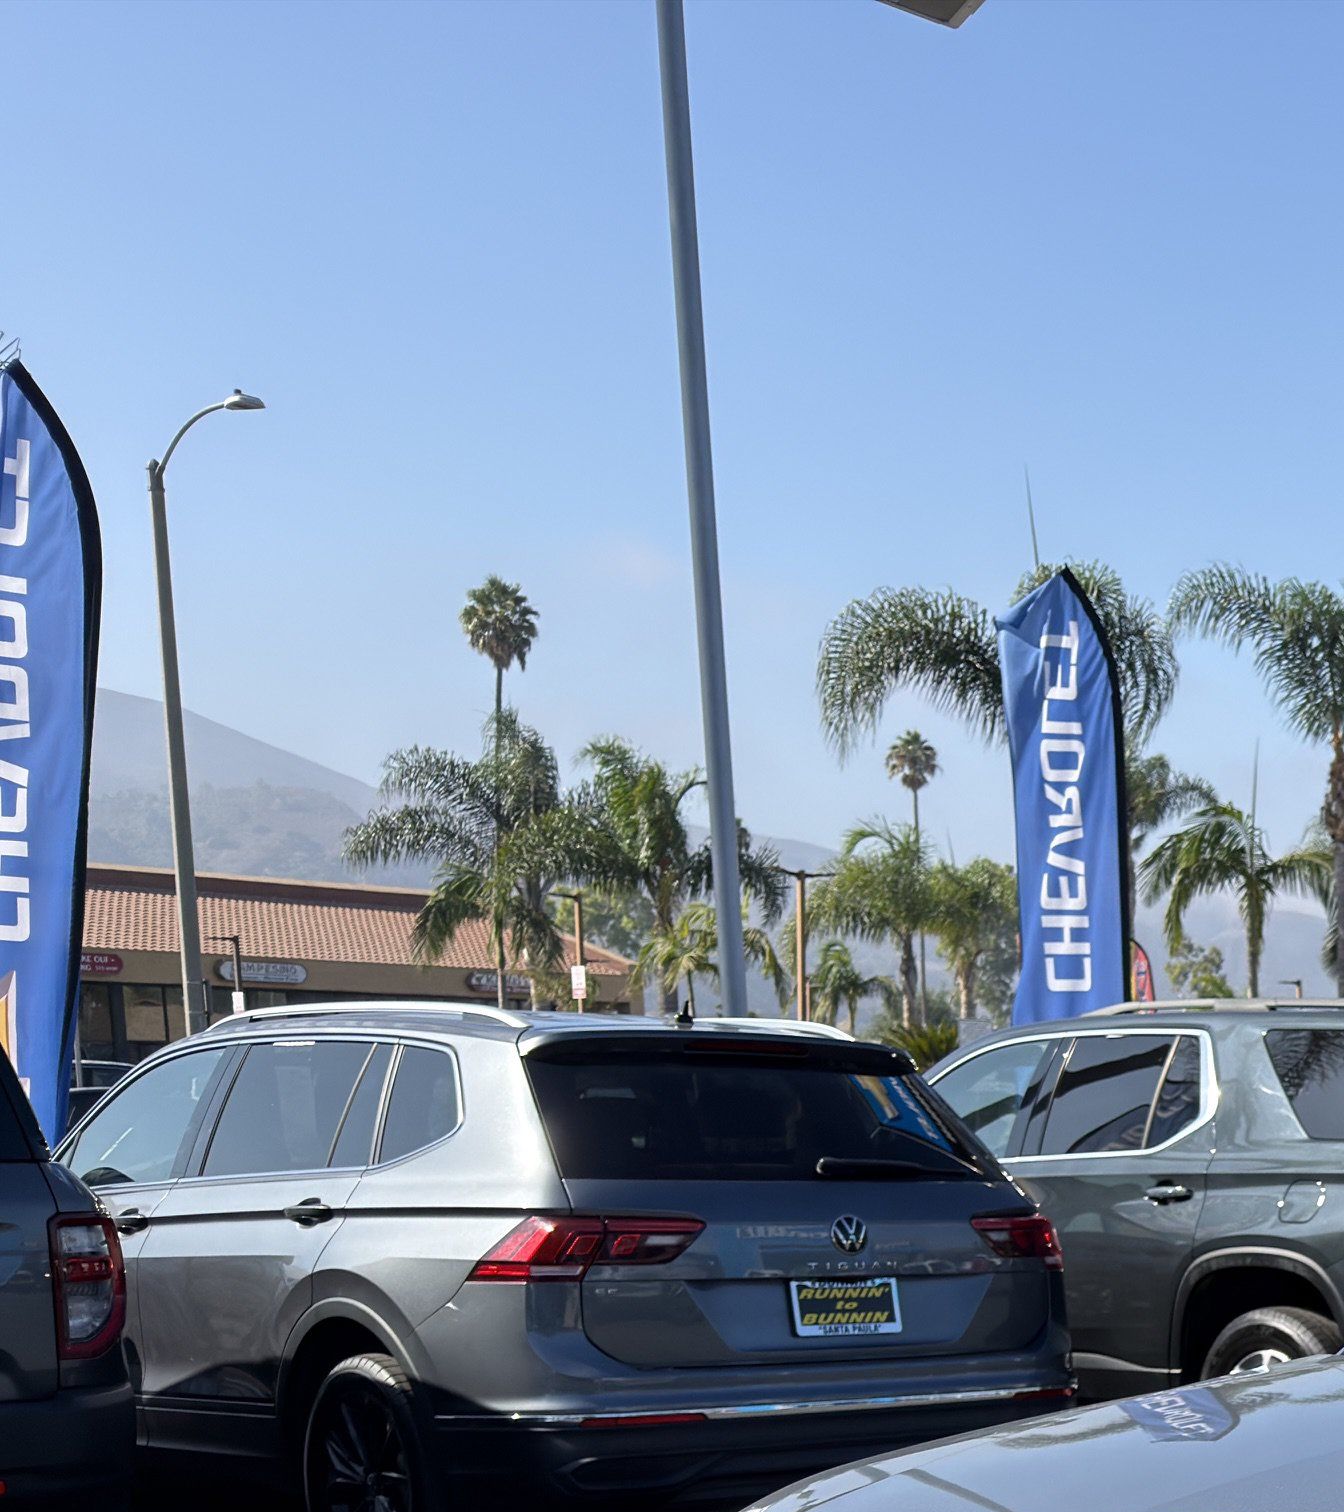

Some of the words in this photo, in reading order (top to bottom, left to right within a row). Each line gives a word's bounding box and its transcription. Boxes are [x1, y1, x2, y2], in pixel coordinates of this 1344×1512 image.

[806, 1260, 898, 1273] TIGUAN
[798, 1285, 891, 1300] RUNNIN'
[834, 1299, 860, 1311] to
[801, 1310, 891, 1326] BUNNIN
